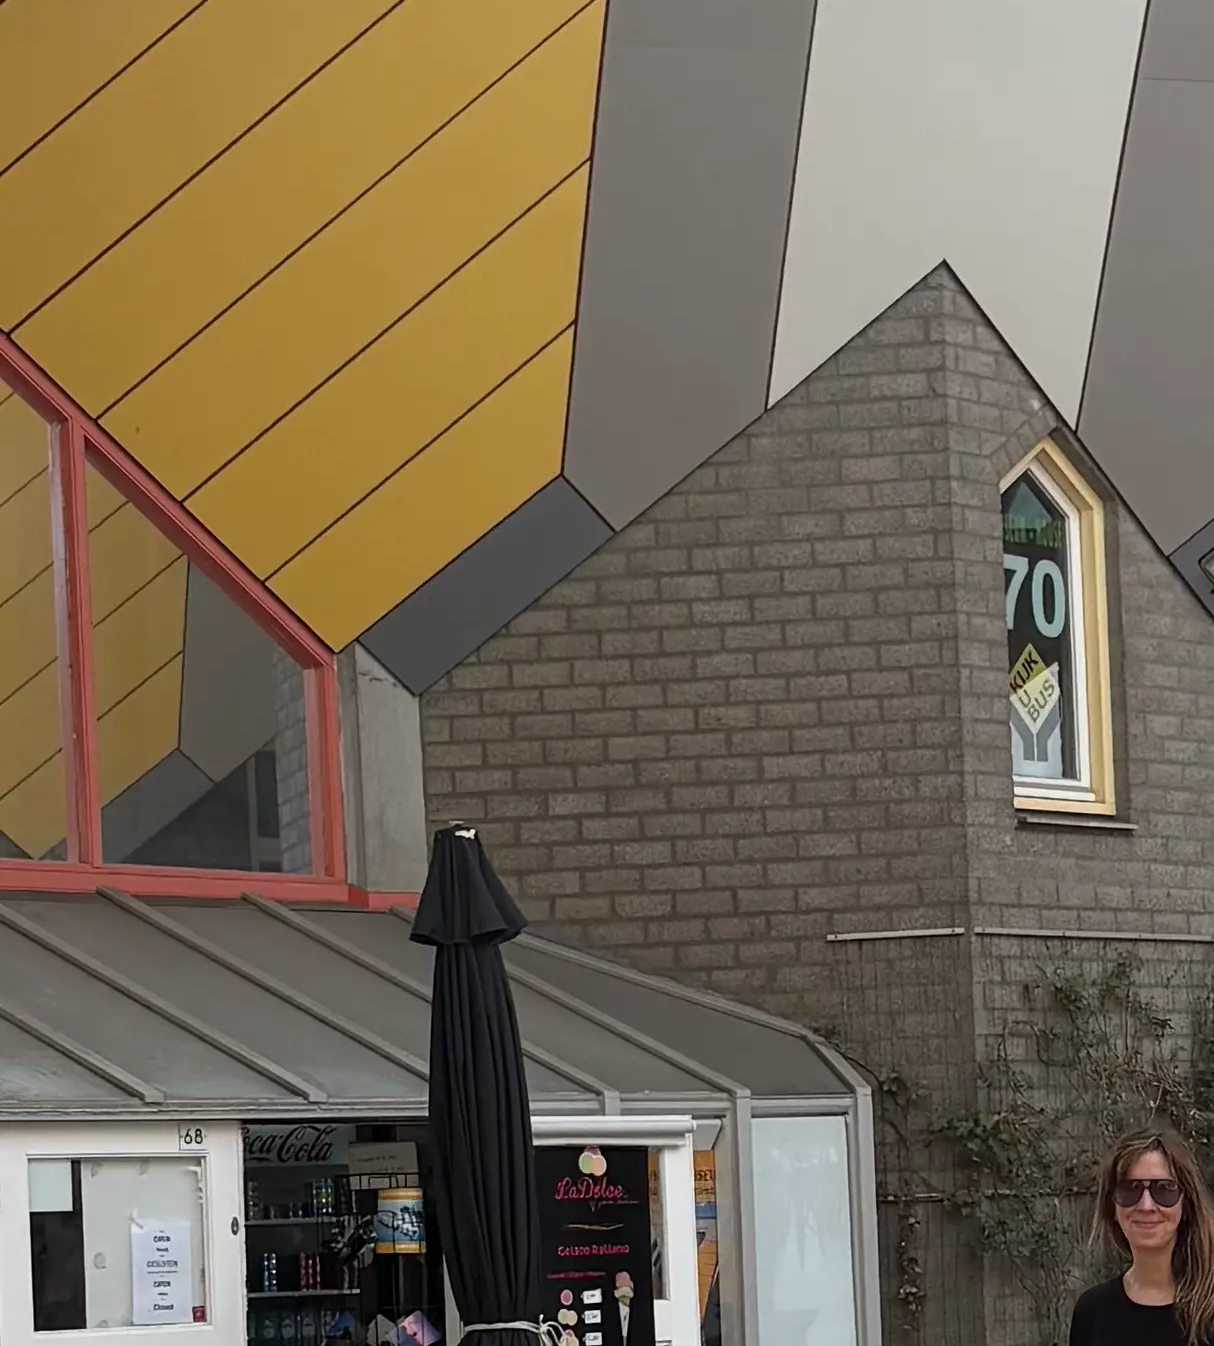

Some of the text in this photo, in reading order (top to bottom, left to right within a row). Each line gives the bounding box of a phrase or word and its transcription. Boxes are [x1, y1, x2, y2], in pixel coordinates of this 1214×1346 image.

[1002, 554, 1066, 639] 70
[1009, 651, 1039, 694] KIJK
[183, 1128, 204, 1145] 68
[243, 1125, 337, 1163] oca-Cola
